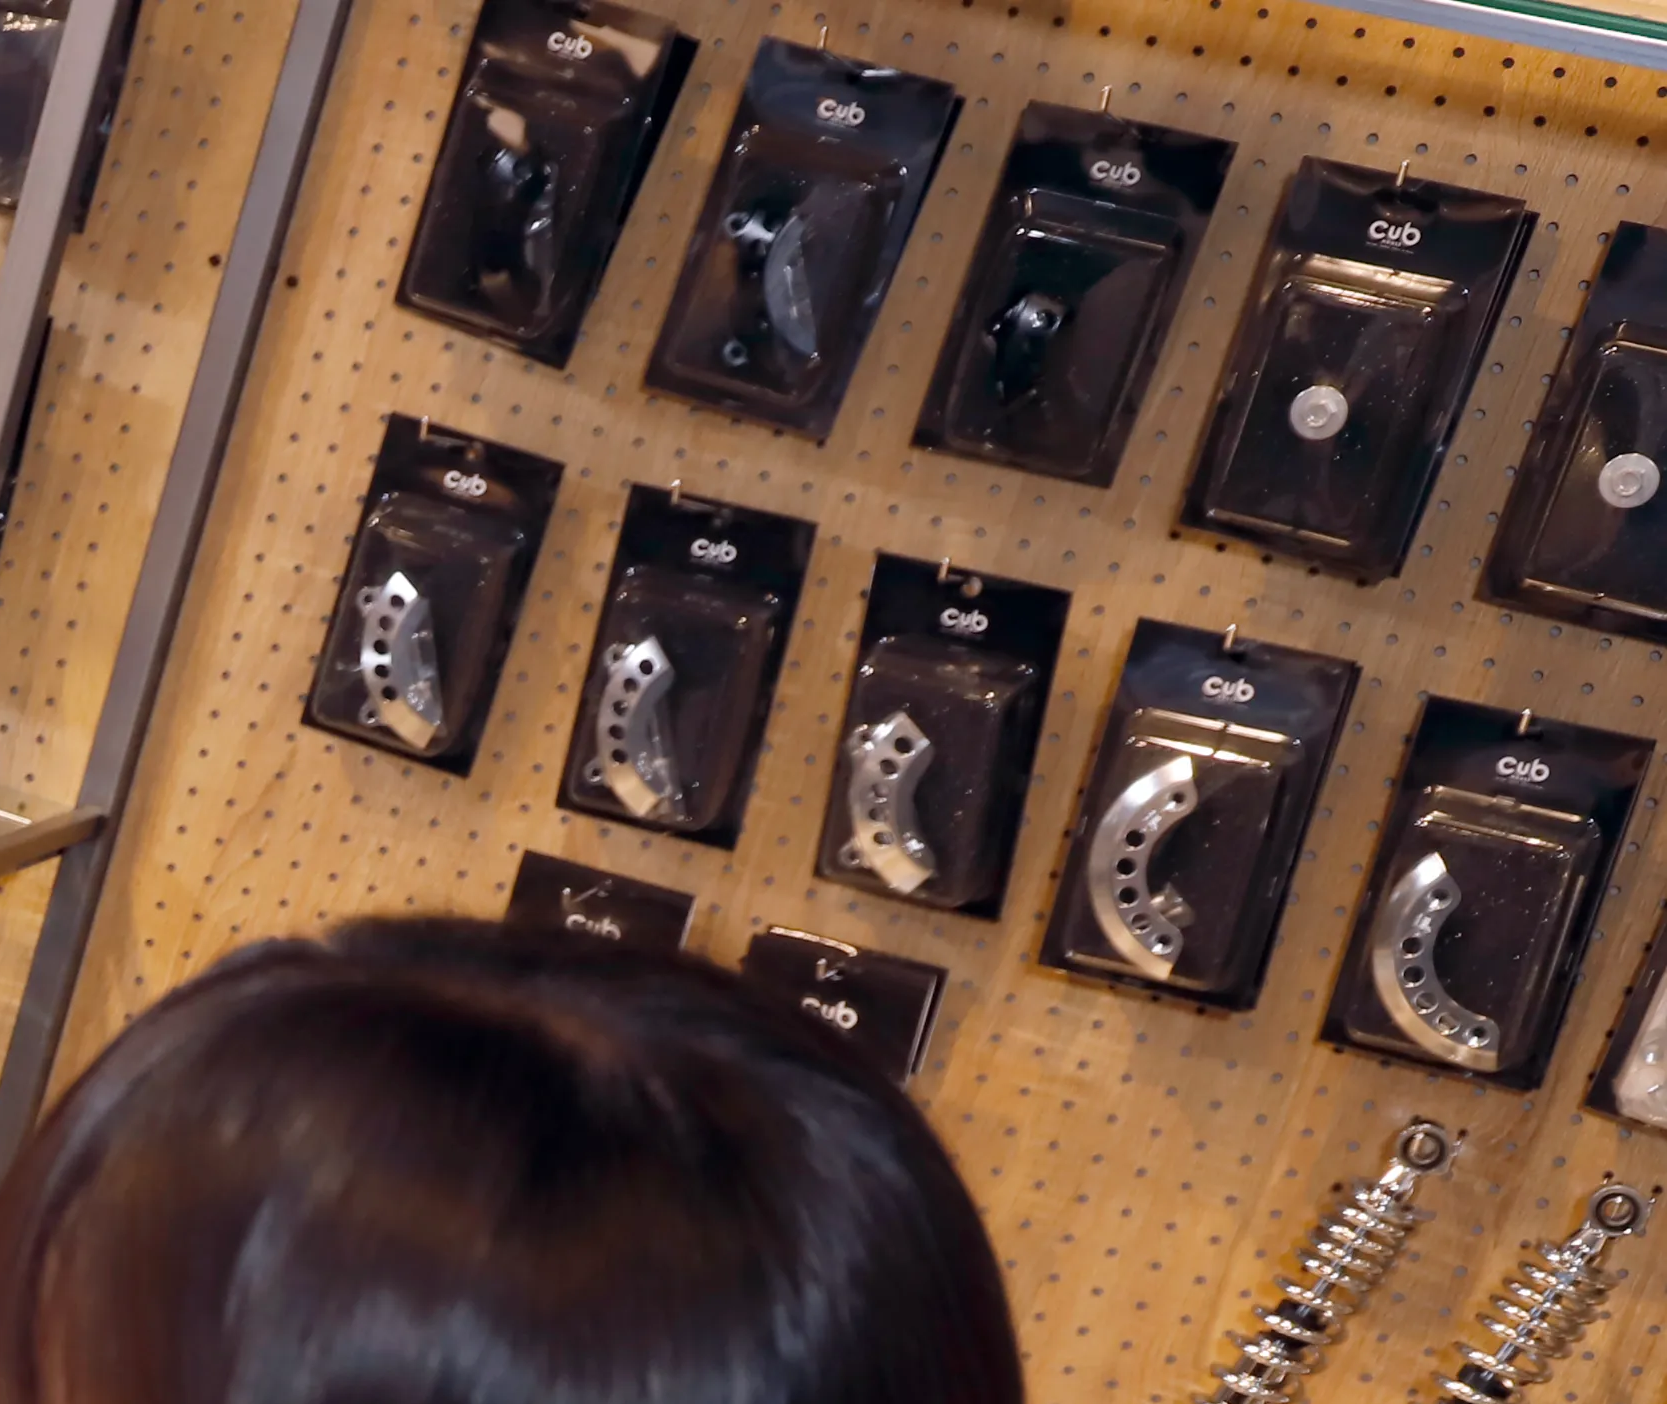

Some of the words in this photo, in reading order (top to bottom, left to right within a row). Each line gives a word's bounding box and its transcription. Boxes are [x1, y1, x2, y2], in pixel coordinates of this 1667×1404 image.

[547, 31, 593, 60] Cub
[817, 98, 866, 126] Cub
[1089, 160, 1142, 186] Cub
[1368, 219, 1422, 247] Cub
[443, 470, 487, 497] Cub
[690, 538, 737, 563] Cub
[939, 607, 988, 632] Cub
[1201, 676, 1255, 702] Cub
[1496, 755, 1550, 783] Cub
